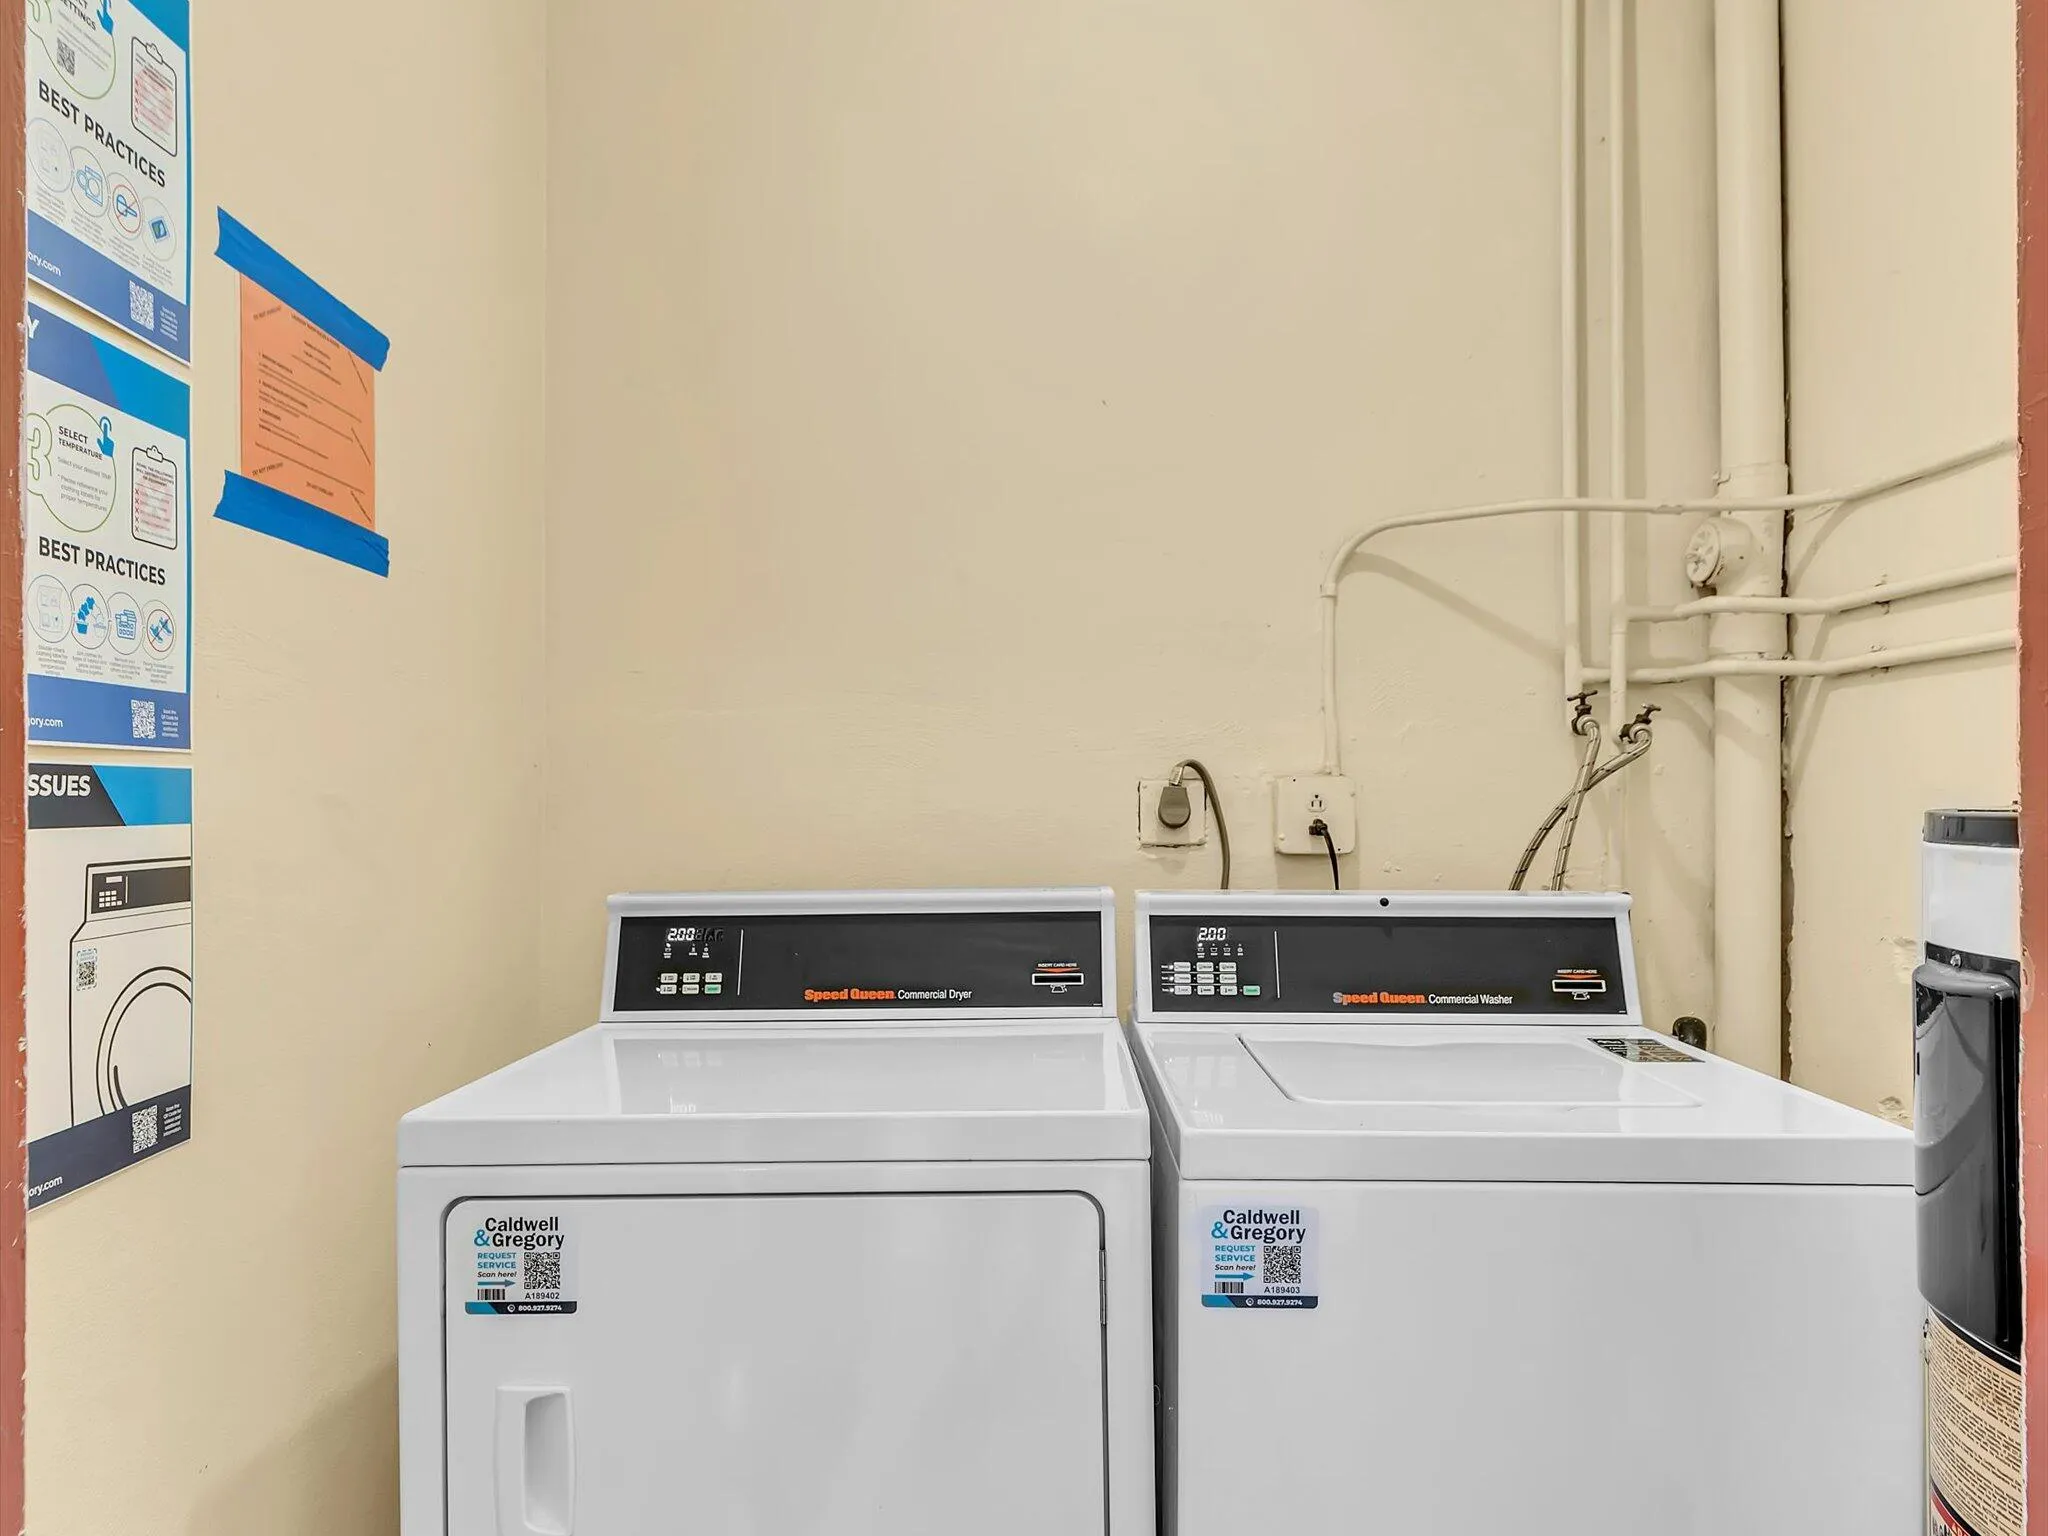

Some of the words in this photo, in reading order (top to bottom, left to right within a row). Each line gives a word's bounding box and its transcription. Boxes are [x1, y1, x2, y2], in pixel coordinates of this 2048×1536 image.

[61, 0, 97, 31] ETTINGS
[39, 78, 80, 125] BEST
[84, 114, 166, 188] PRACTICES
[58, 425, 88, 445] SELECT
[58, 437, 103, 460] TEMPERATURE
[39, 536, 80, 564] BEST
[85, 548, 166, 586] PRACTICES
[27, 717, 64, 728] ory.com
[28, 774, 91, 797] SSUES
[667, 927, 696, 941] 2.00
[1198, 927, 1227, 941] 2.00
[804, 988, 848, 1002] Speed
[850, 988, 895, 1000] Queen
[897, 989, 947, 1000] Commercial
[949, 989, 972, 1001] Dryer
[1332, 992, 1378, 1005] Speed
[1380, 992, 1425, 1004] Queen
[1428, 994, 1479, 1004] Commercial
[1479, 994, 1513, 1004] Washer
[485, 1216, 559, 1232] Caldwell
[1223, 1209, 1300, 1225] Caldwell
[477, 1252, 517, 1260] REQUEST
[1215, 1254, 1256, 1262] SERVICE
[525, 1292, 560, 1300] A189402
[1264, 1286, 1301, 1294] A189403
[518, 1304, 562, 1312] 800.927.9274
